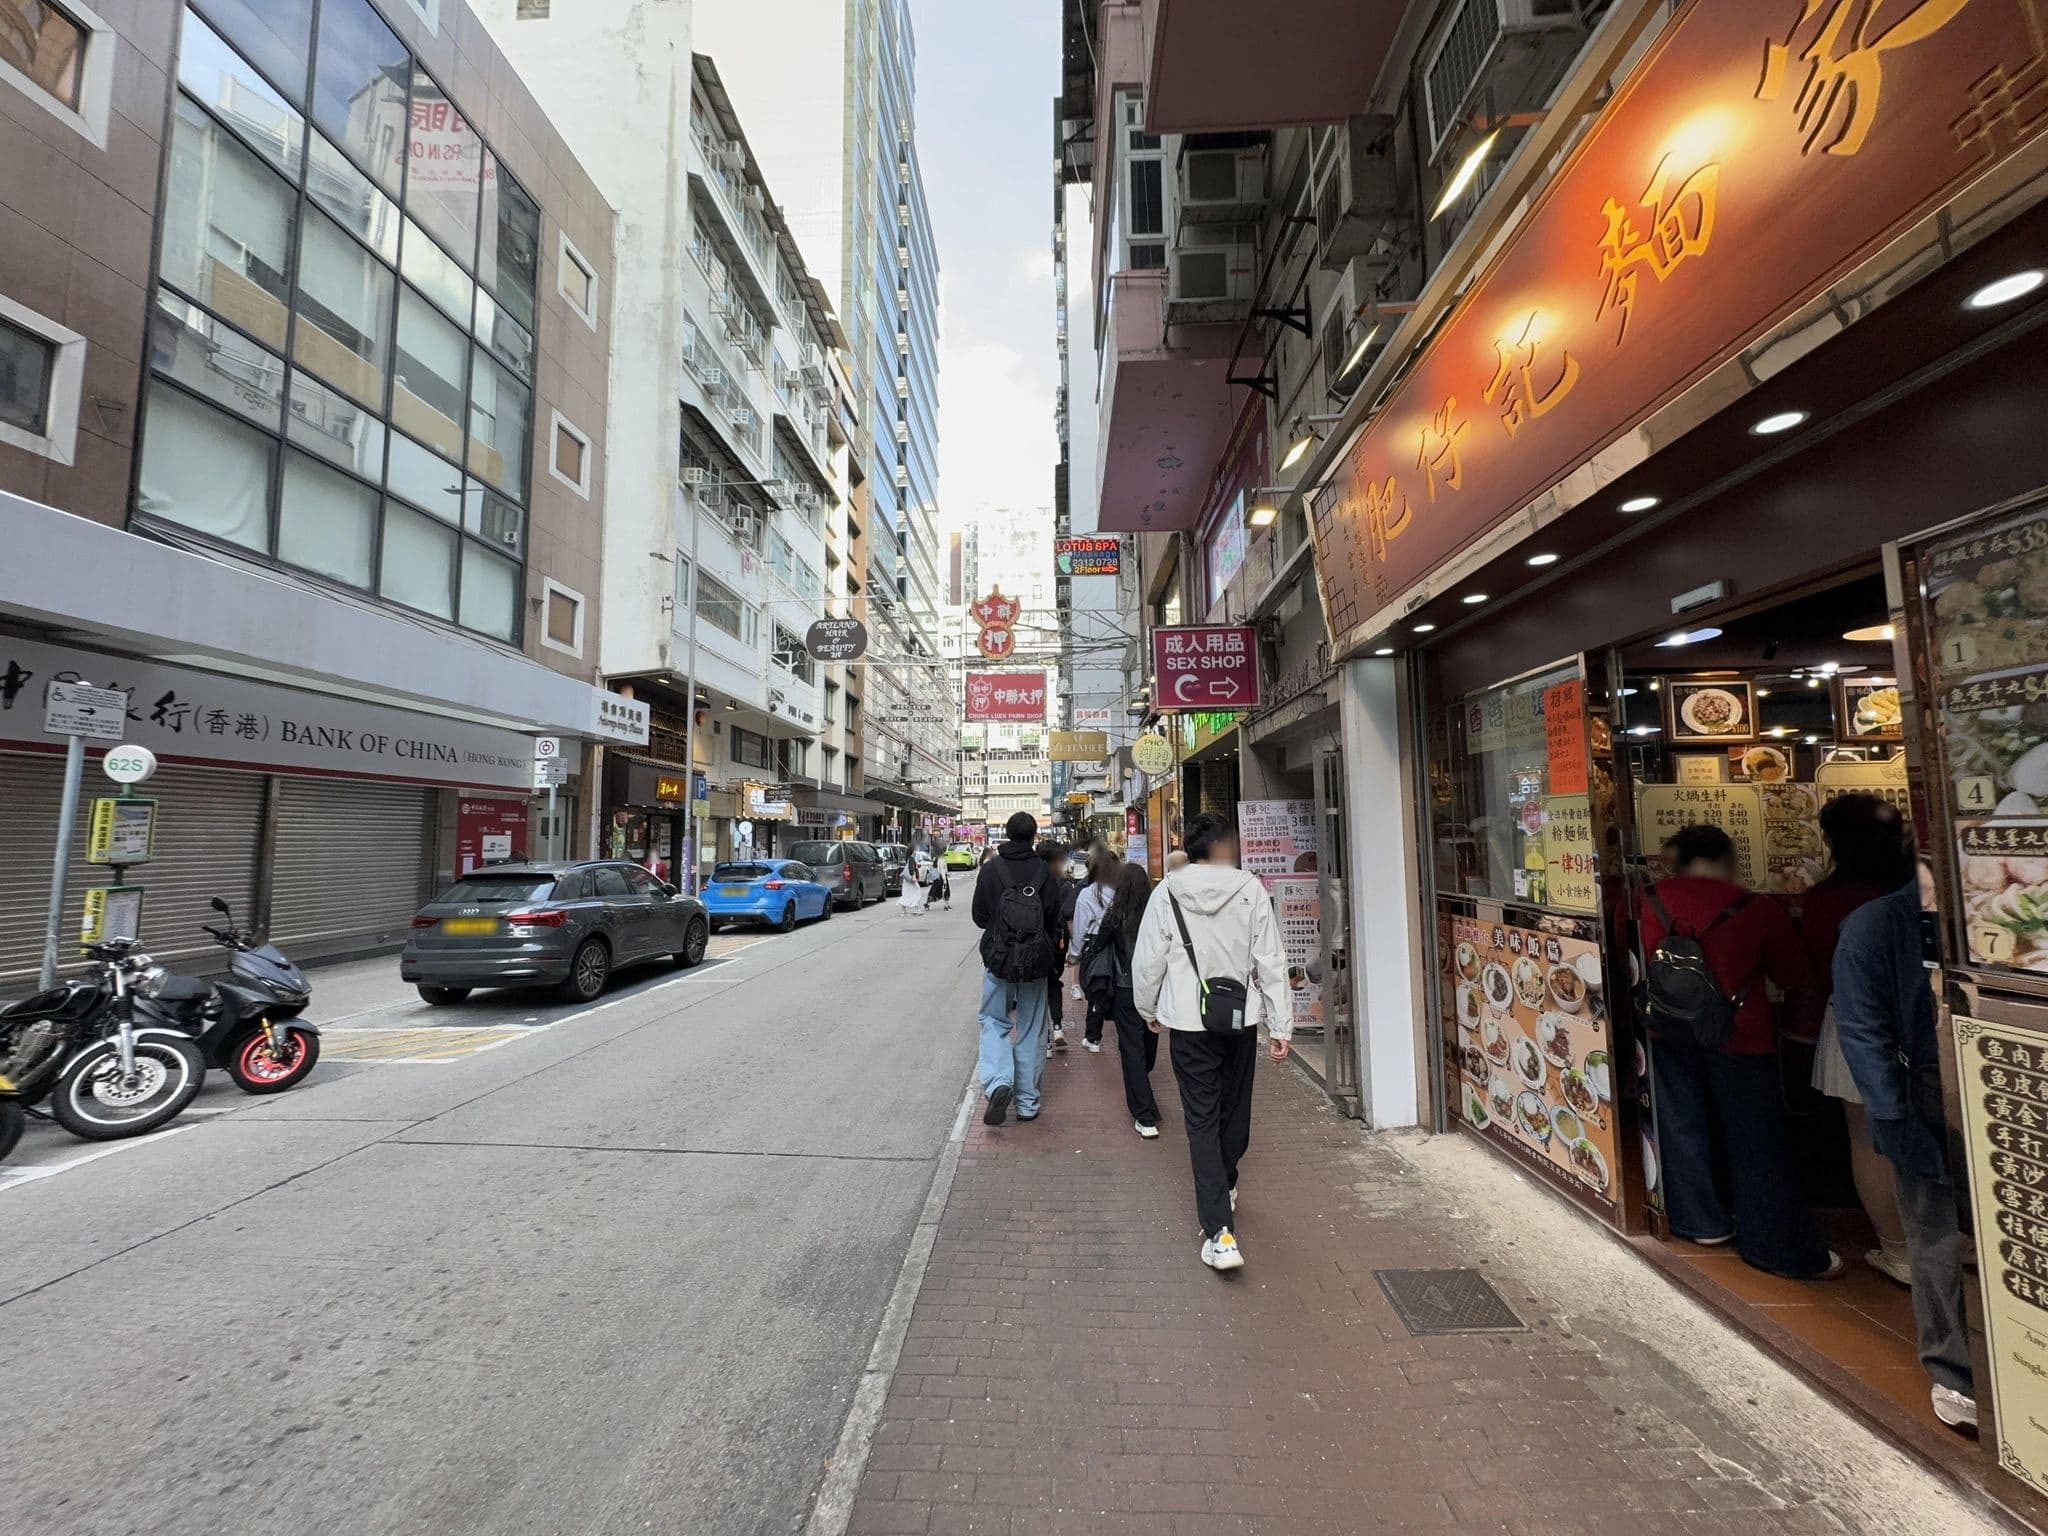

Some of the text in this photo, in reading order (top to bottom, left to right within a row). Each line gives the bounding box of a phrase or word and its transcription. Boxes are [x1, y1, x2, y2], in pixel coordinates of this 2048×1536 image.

[1056, 542, 1117, 552] LOTUS SPA
[1096, 558, 1118, 566] 0728
[816, 621, 858, 630] ARTLAND
[825, 629, 848, 638] HAIR
[816, 643, 856, 652] BEAUTY
[984, 630, 1008, 652] 押
[1166, 633, 1245, 654] 成人用品
[1952, 642, 1964, 664] 1
[1166, 656, 1246, 670] SEX SHOP
[994, 688, 1043, 706] 中聯大押
[1950, 680, 2026, 705] 魚蛋牛丸
[281, 720, 526, 769] BANK OF CHINA (HONG KONG)
[108, 758, 144, 772] 62S
[698, 780, 706, 798] P
[1968, 782, 1984, 804] 4
[1704, 810, 1722, 818] $20
[1729, 810, 1748, 818] $40
[1730, 818, 1748, 826] $50
[1552, 824, 1589, 842] 粉麵飯
[1548, 852, 1594, 876] 一律9折
[1558, 884, 1592, 900] 小食除外
[1984, 932, 2000, 954] 7
[1990, 1096, 2048, 1130] 黃金
[1996, 1126, 2048, 1159] 手打
